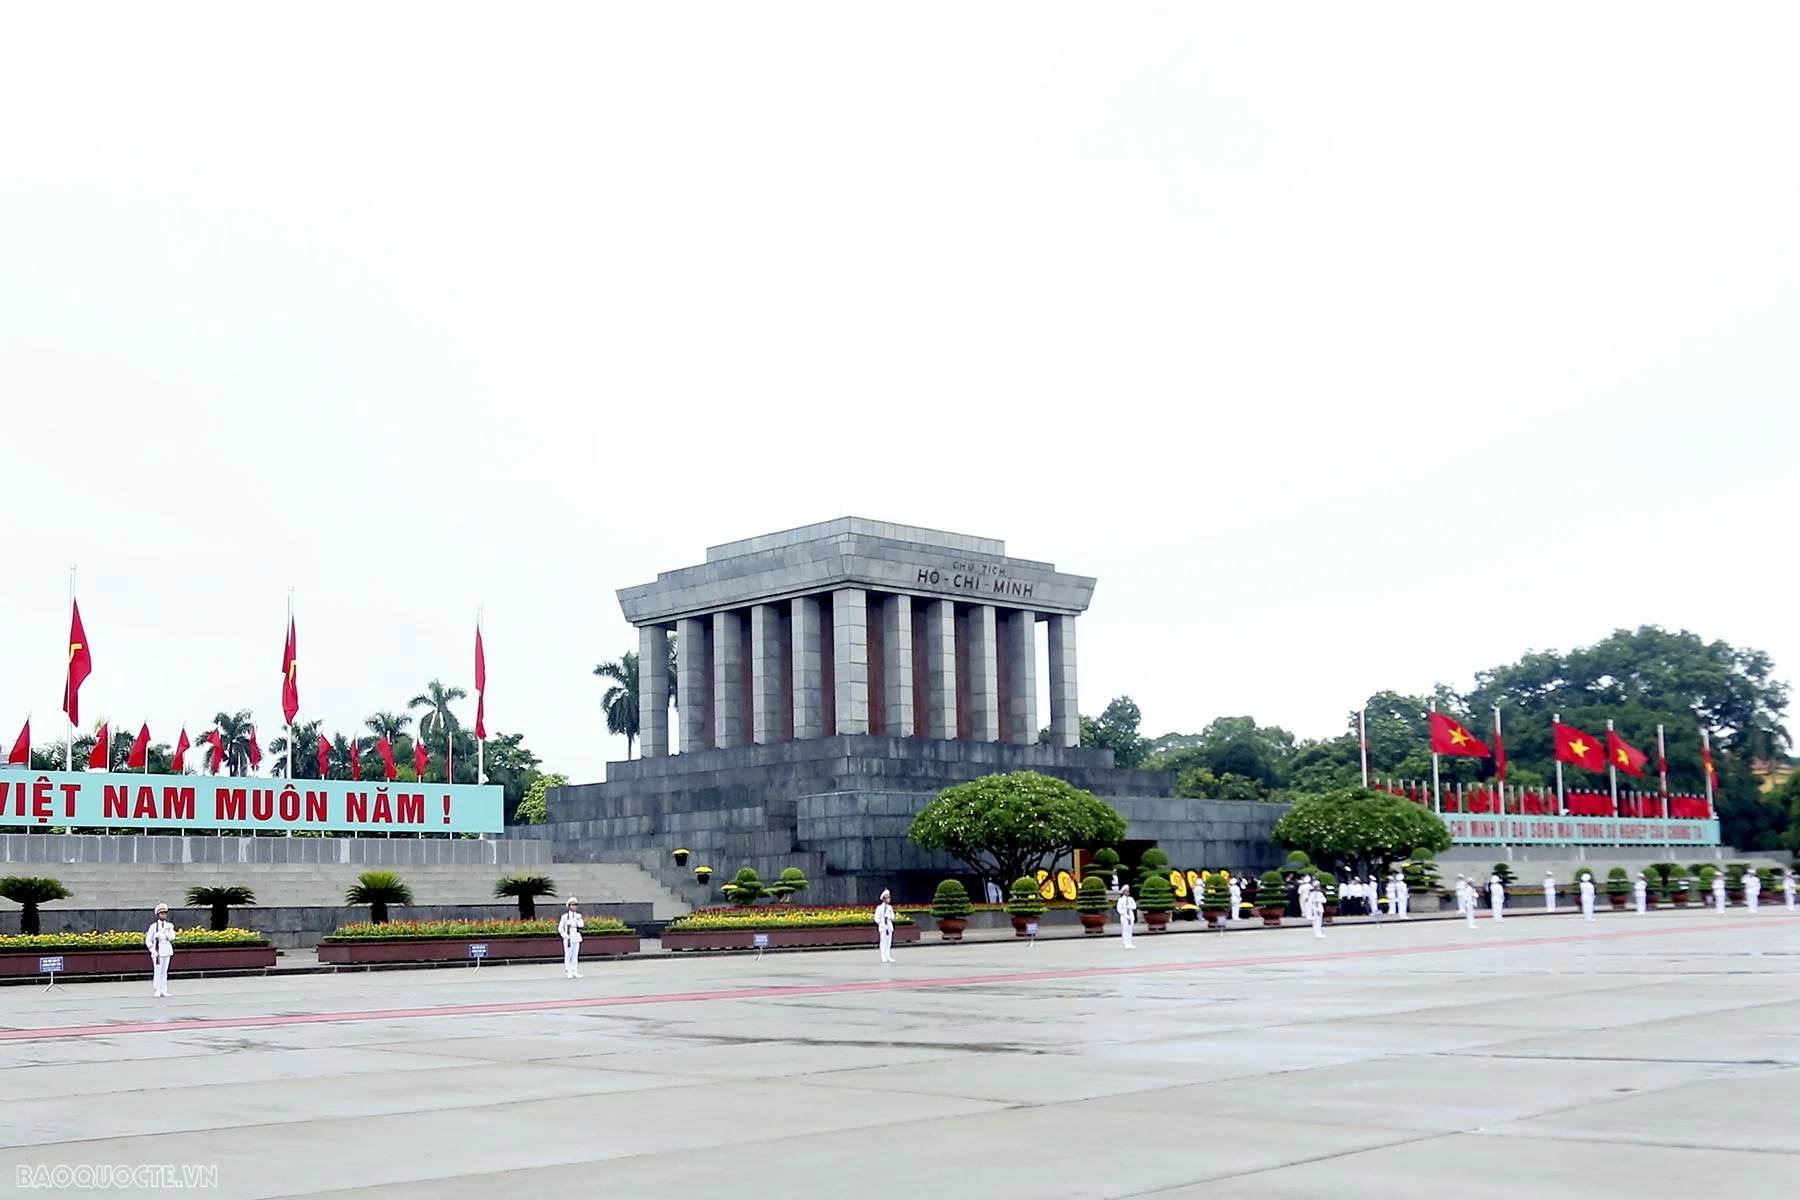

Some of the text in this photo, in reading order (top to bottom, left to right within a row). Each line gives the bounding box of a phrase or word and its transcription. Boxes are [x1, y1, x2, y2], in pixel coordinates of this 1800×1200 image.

[104, 785, 195, 820] NAM
[215, 783, 328, 822] MUÔN
[346, 786, 425, 824] NĂM
[443, 795, 452, 824] !
